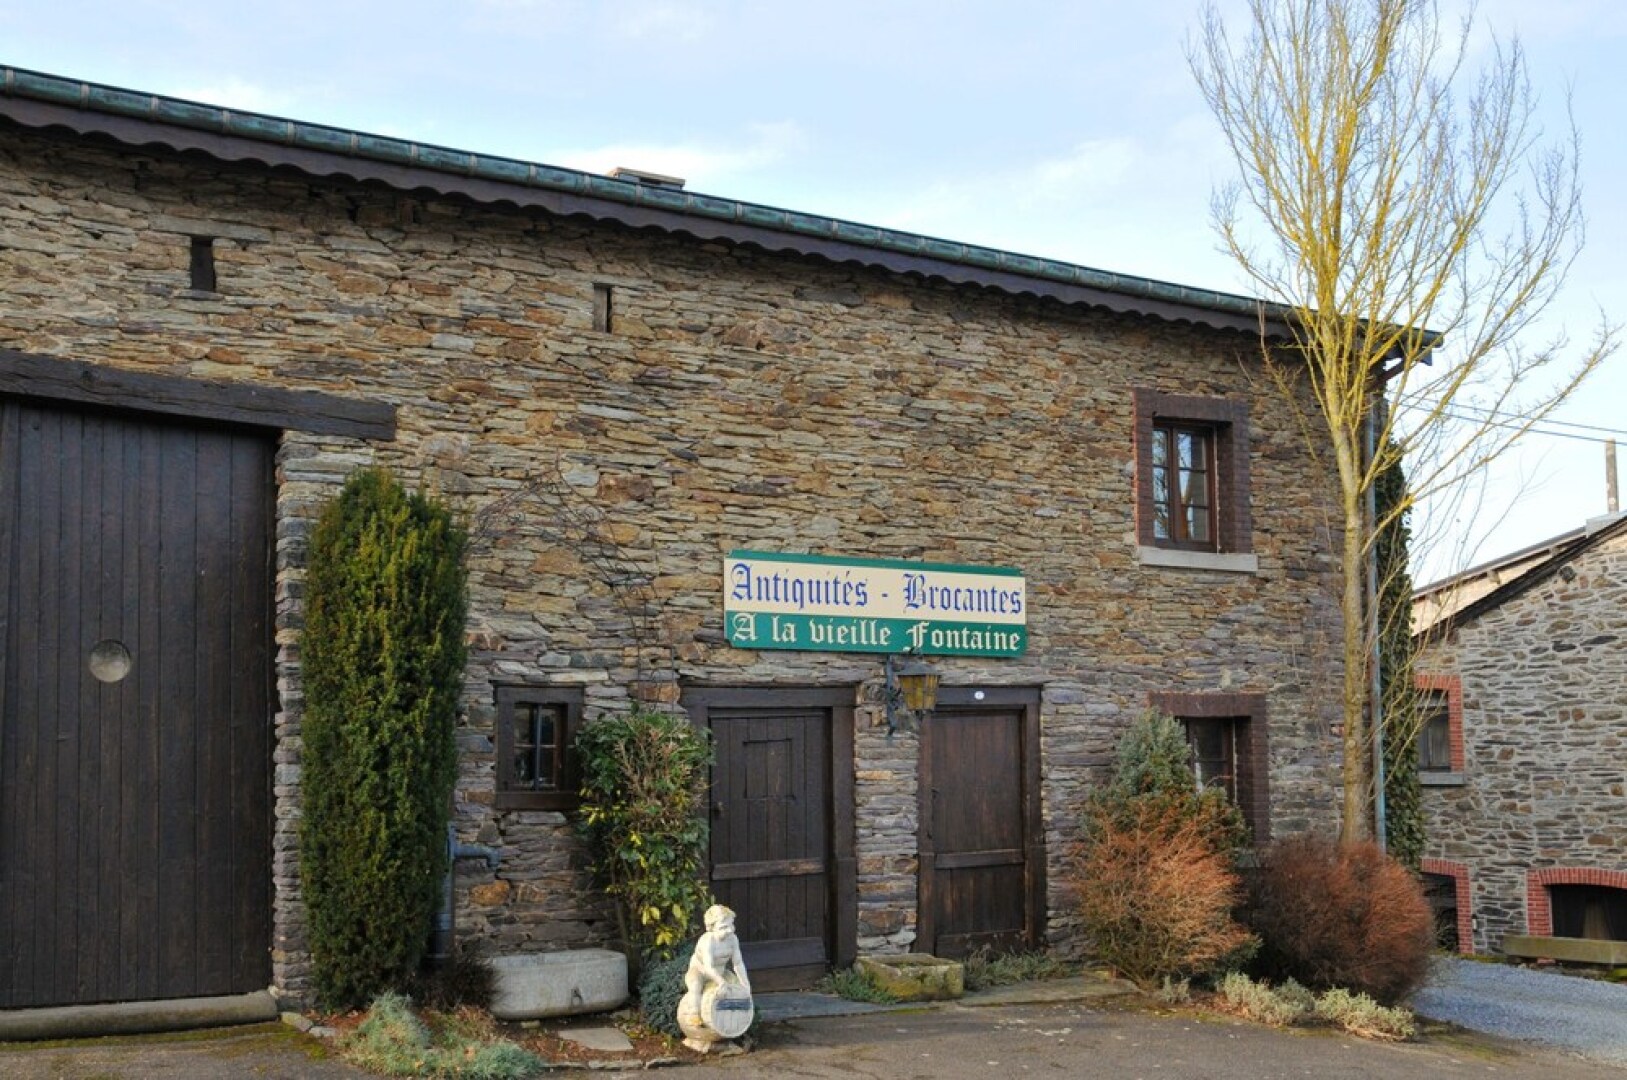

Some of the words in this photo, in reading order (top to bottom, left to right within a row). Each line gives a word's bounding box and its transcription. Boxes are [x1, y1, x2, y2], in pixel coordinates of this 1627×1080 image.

[731, 563, 868, 610] Antiquités
[903, 573, 1022, 614] Brocantes
[731, 612, 757, 642] A
[772, 614, 797, 643] la
[809, 618, 891, 646] vieille
[903, 621, 1020, 652] Fontaine
